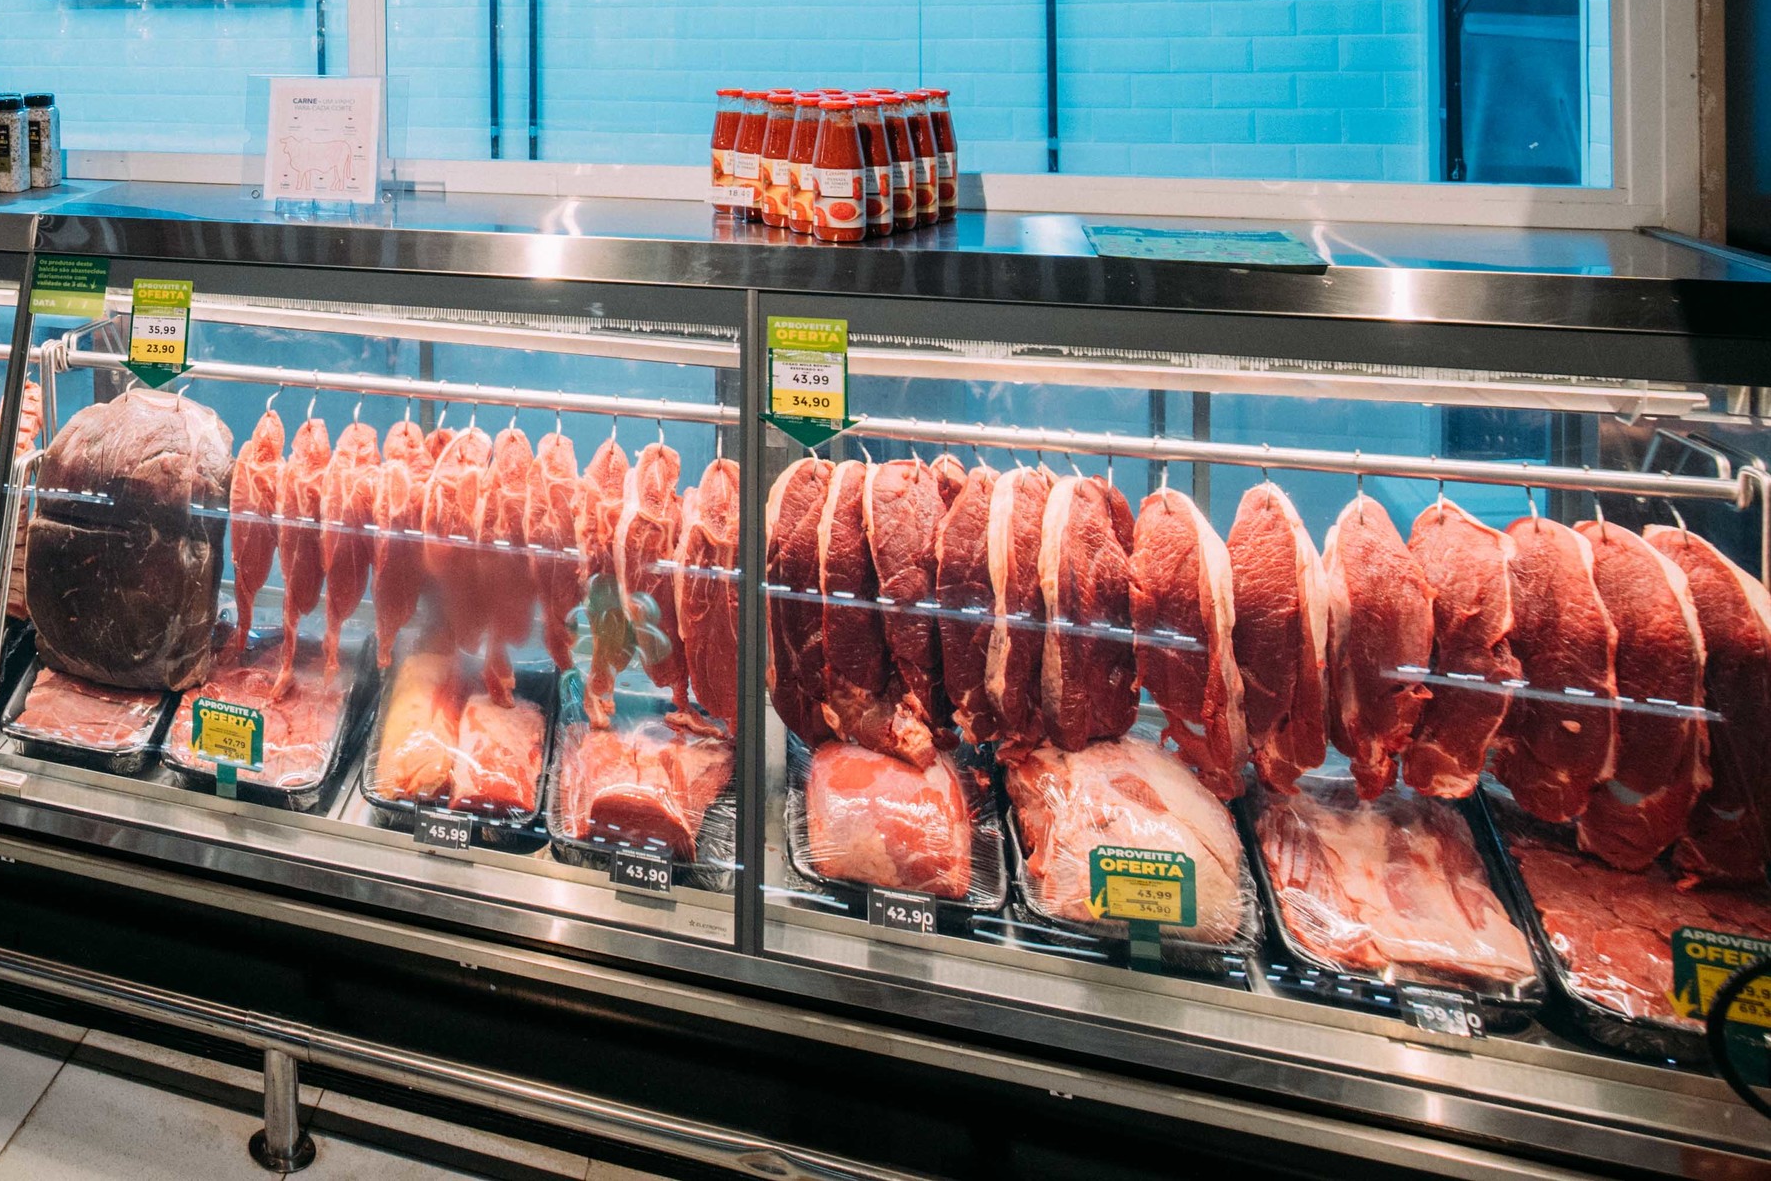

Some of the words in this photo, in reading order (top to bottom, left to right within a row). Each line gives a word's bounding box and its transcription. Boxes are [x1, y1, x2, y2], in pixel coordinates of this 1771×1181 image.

[138, 289, 185, 300] OFERTA
[148, 325, 176, 334] 35,99
[774, 321, 831, 331] APROVEITE
[776, 329, 839, 343] OFERTA
[147, 344, 175, 354] 23,90
[793, 374, 829, 385] 43,99
[793, 396, 829, 407] 34,90
[198, 699, 249, 716] APROVEITE
[251, 710, 258, 718] A
[200, 709, 256, 730] OFERTA
[429, 825, 468, 842] 45,99
[1097, 847, 1172, 862] APROVEITE
[1175, 855, 1186, 863] A
[626, 865, 668, 884] 43,90
[1099, 858, 1184, 877] OFERTA
